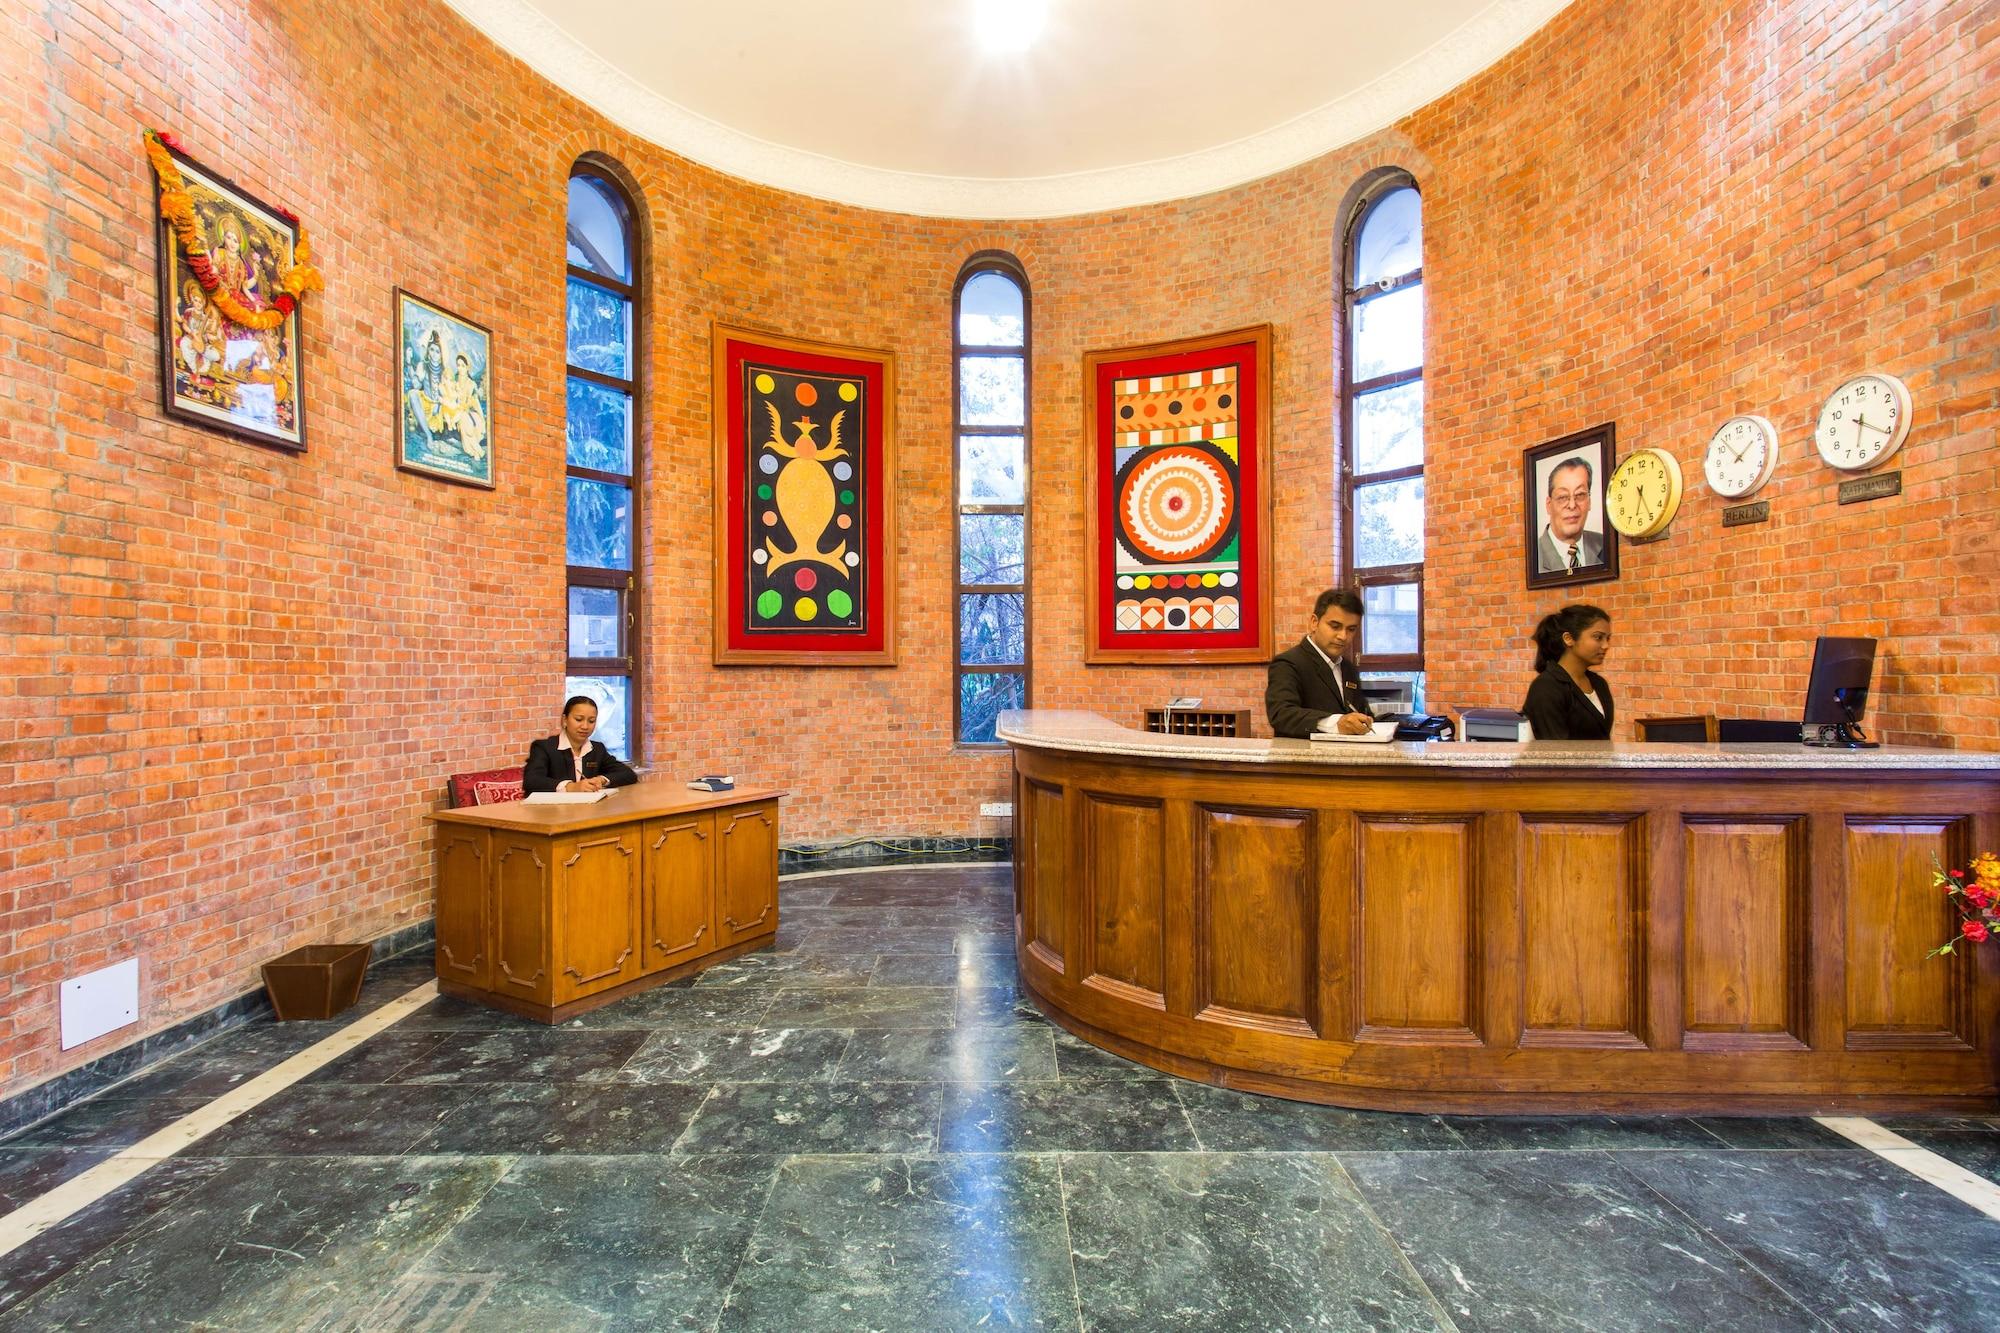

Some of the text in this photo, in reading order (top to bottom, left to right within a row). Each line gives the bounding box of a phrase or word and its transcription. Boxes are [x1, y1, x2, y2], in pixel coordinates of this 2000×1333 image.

[1856, 386, 1865, 396] 12
[1841, 396, 1848, 405] 11
[1885, 394, 1891, 403] 2
[1832, 410, 1842, 421] 10
[1889, 408, 1895, 418] 3
[1830, 427, 1836, 436] 9
[1885, 426, 1891, 434] 4
[1834, 441, 1840, 450] 8
[1875, 441, 1880, 450] 5
[1846, 450, 1851, 458] 7
[1859, 450, 1866, 458] 6
[1726, 506, 1763, 522] BERLIN
